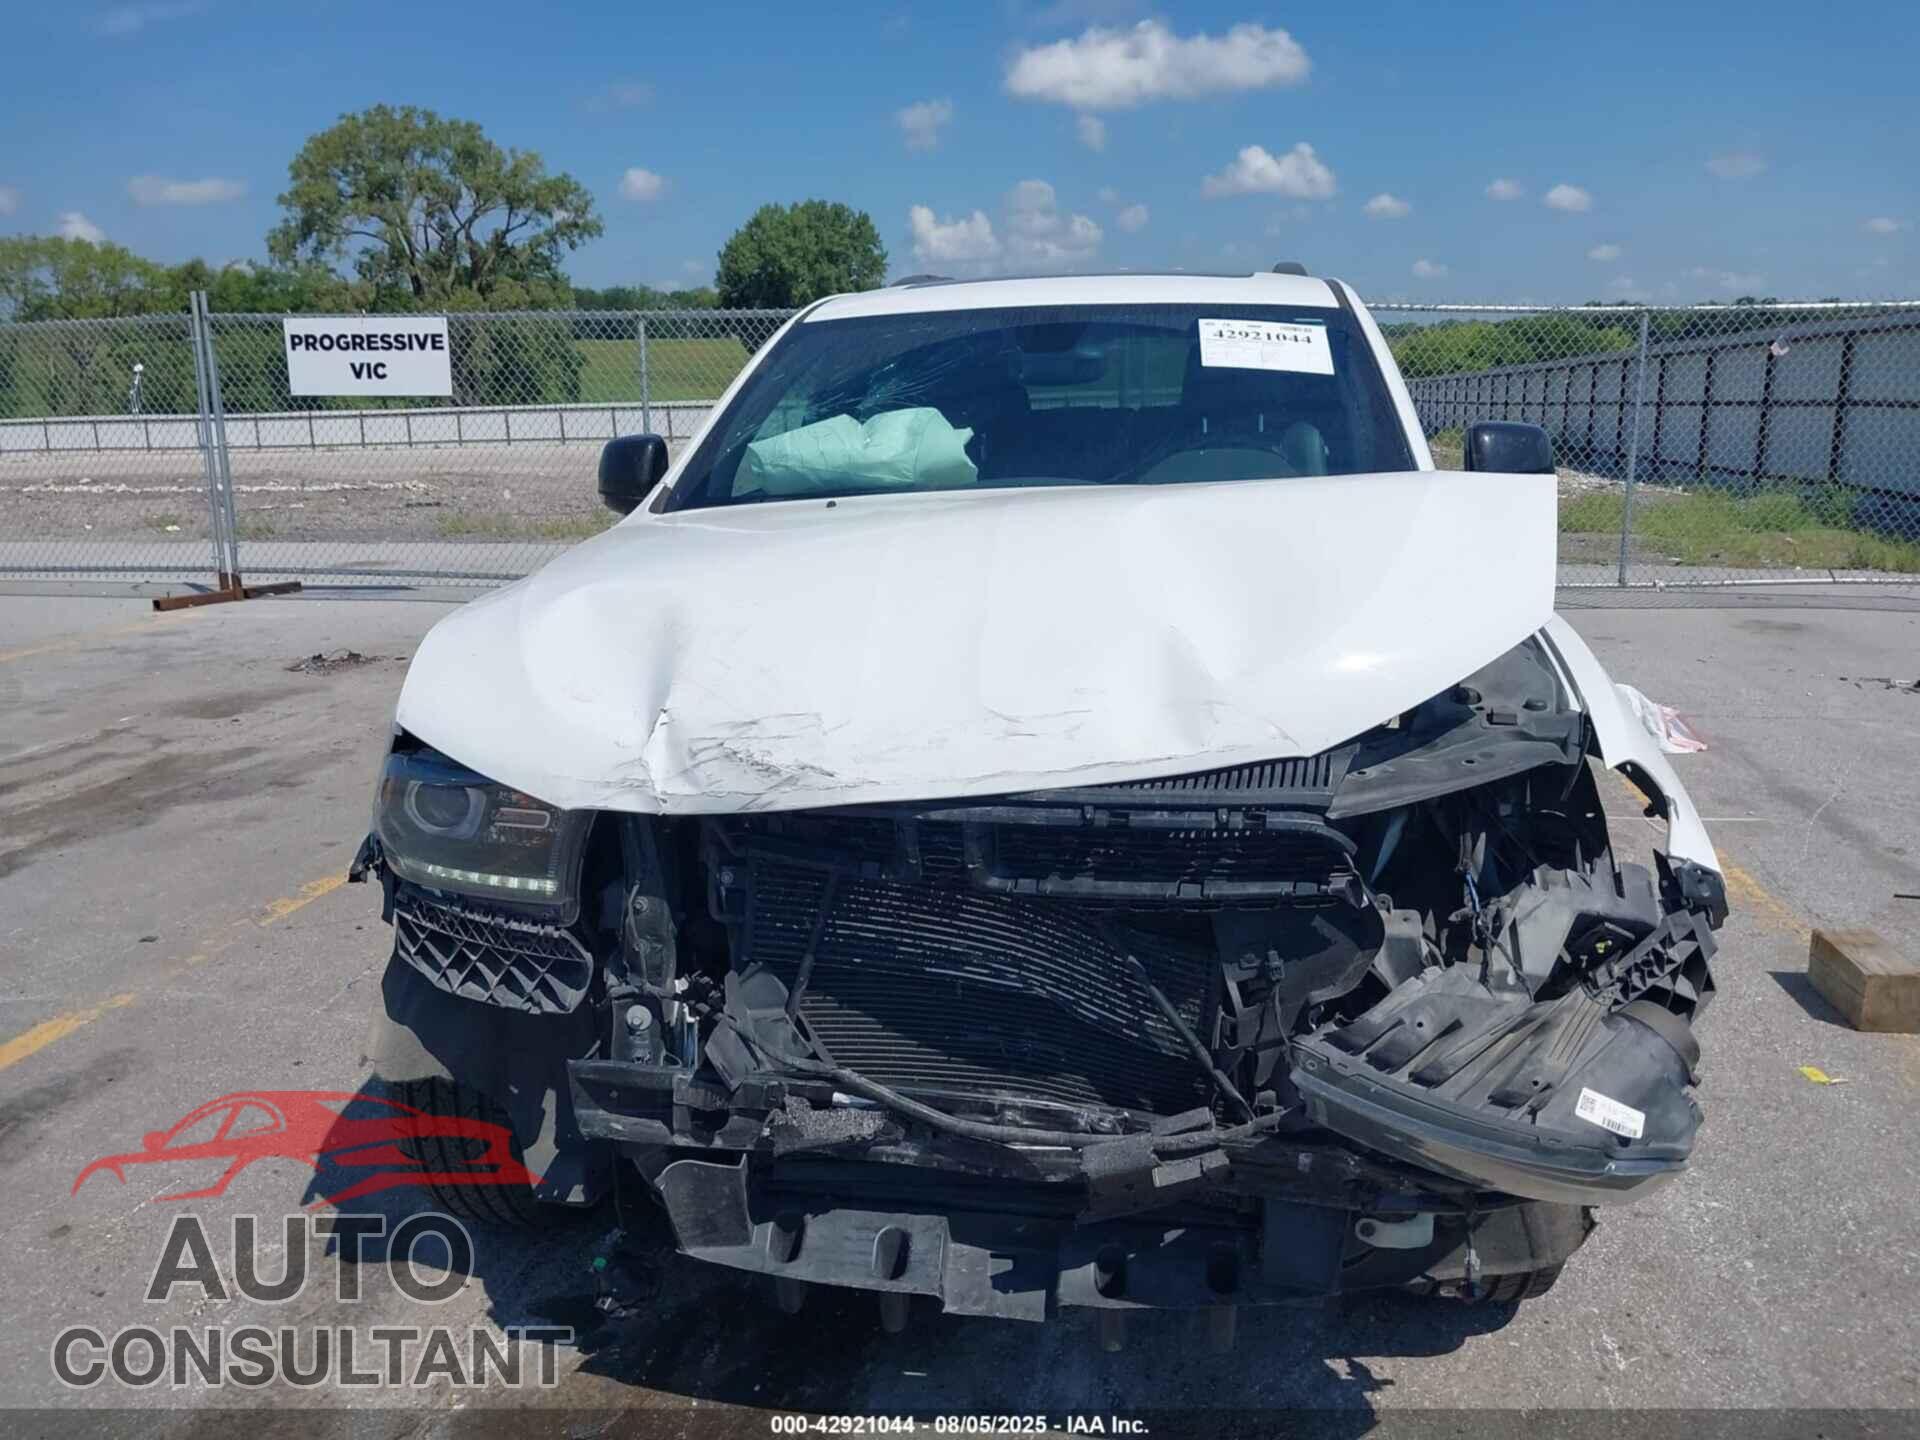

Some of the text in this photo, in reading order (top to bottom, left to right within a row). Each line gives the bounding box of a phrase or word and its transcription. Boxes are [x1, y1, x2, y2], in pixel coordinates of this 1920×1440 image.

[290, 333, 445, 351] PROGRESSIVE
[1213, 329, 1312, 344] 42921044
[350, 362, 388, 380] VIC
